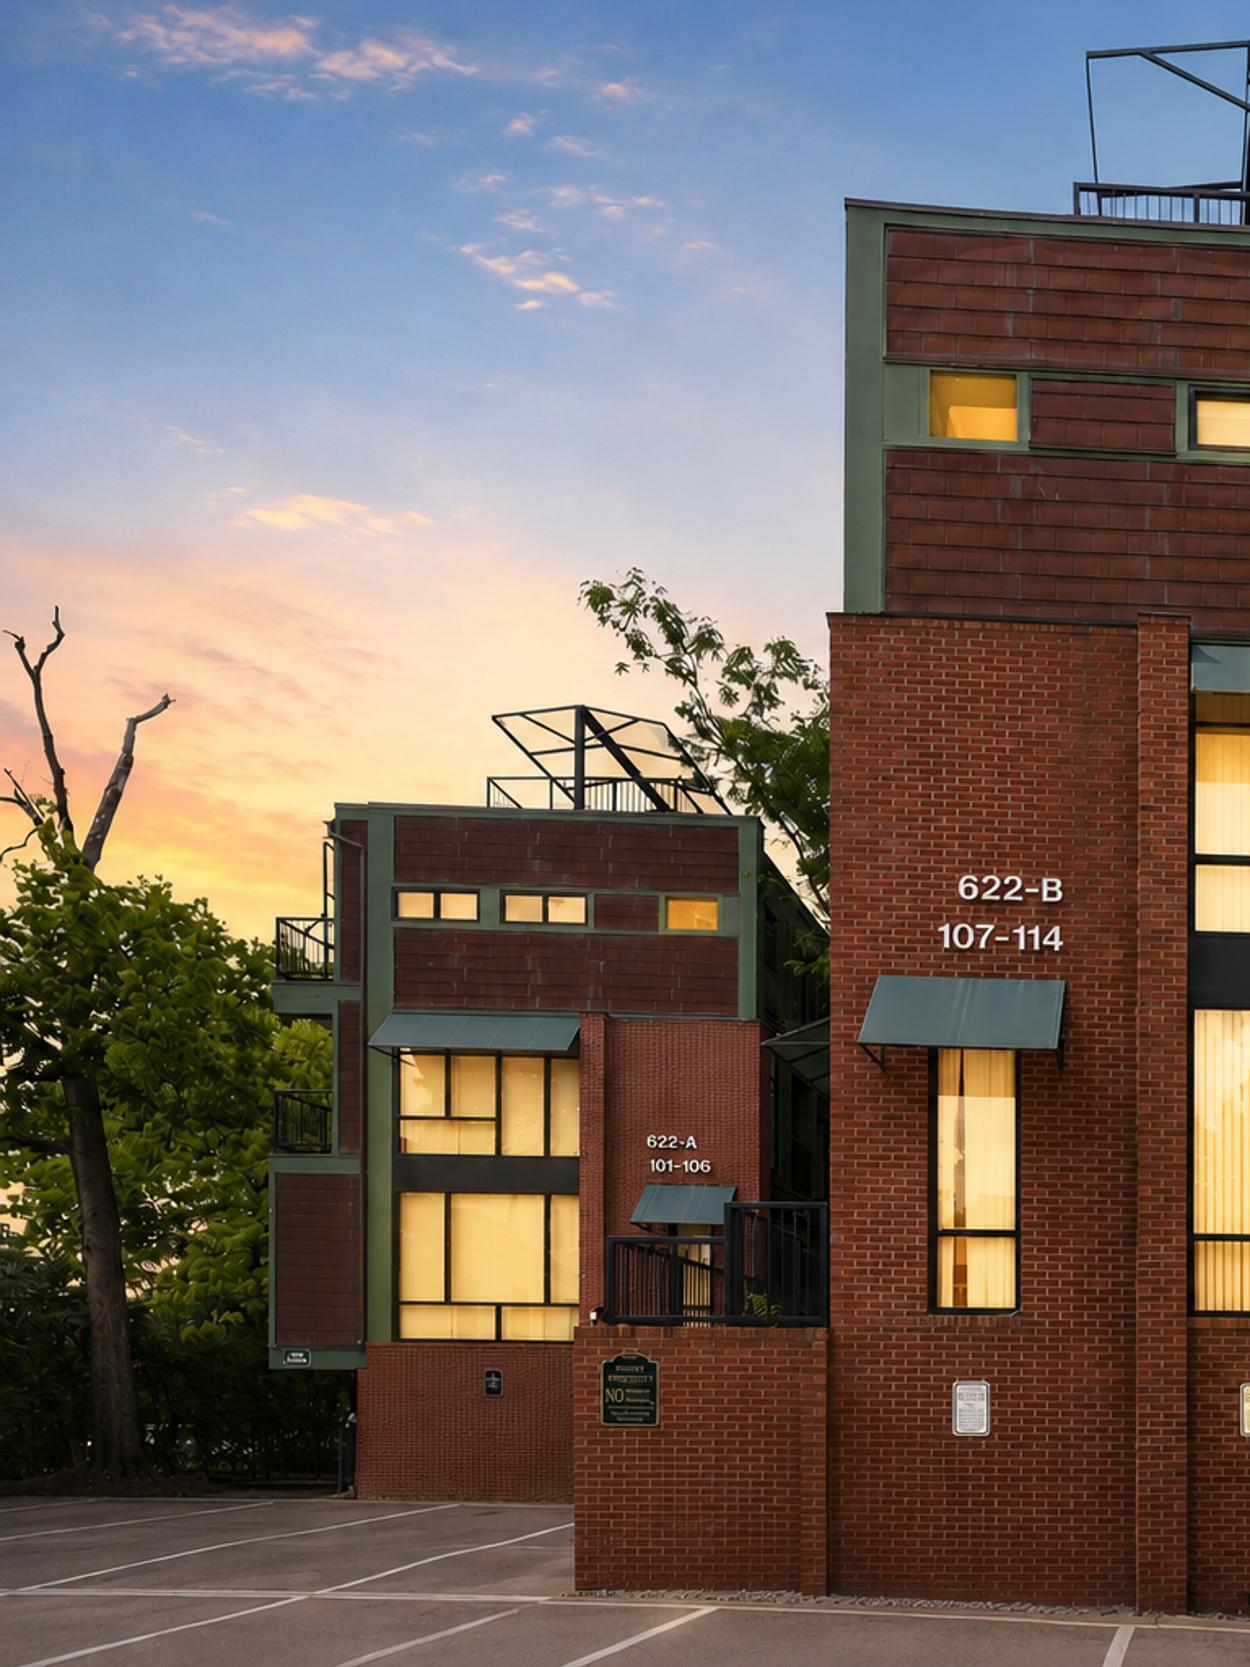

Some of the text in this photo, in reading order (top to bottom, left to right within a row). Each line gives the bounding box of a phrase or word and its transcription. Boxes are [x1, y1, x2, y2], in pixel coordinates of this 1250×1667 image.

[958, 875, 1063, 902] 622-B
[937, 923, 1064, 951] 107-114
[646, 1134, 698, 1149] 622-A
[650, 1158, 711, 1173] 101-106
[605, 1388, 624, 1403] NO
